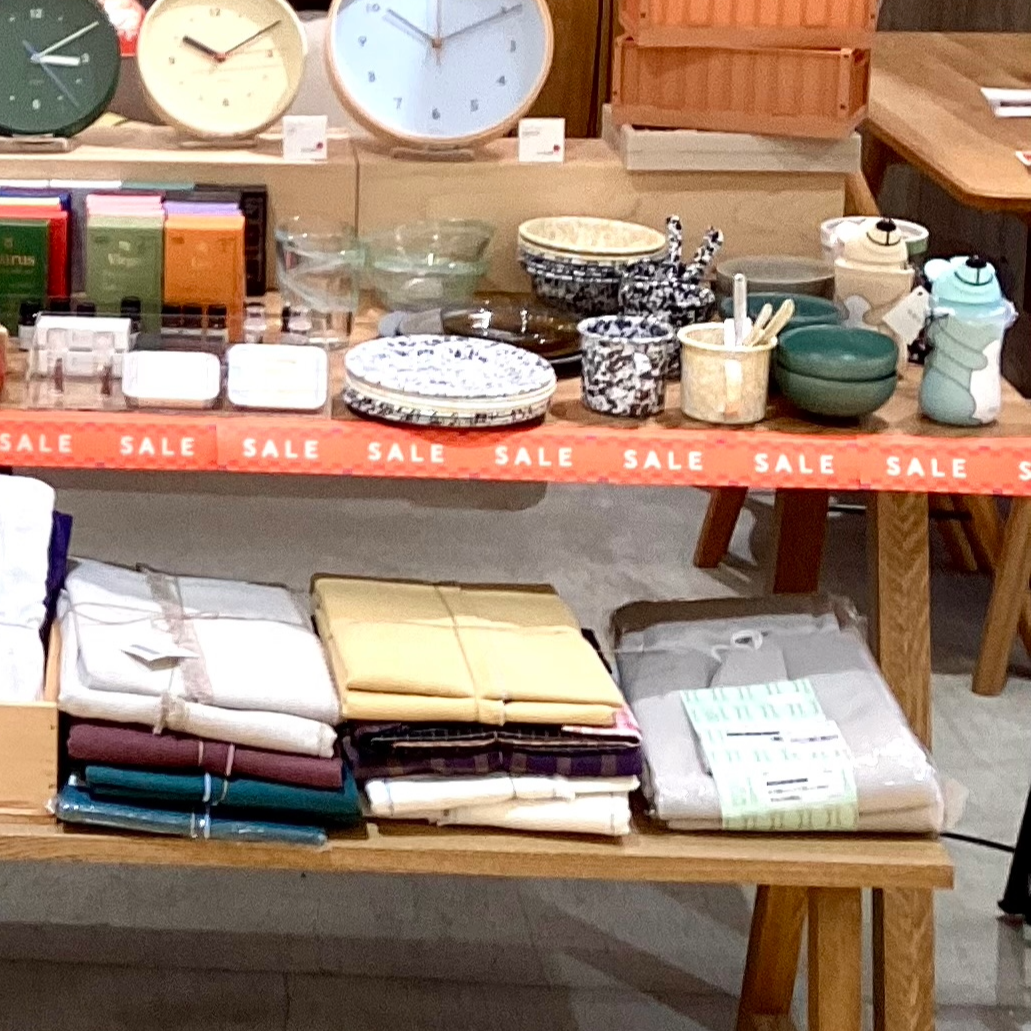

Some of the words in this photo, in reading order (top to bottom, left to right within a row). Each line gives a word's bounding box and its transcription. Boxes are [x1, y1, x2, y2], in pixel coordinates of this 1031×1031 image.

[366, 3, 380, 13] 10
[393, 97, 403, 110] 7
[431, 107, 441, 120] 6
[120, 435, 195, 456] SALE
[243, 437, 319, 459] SALE
[368, 442, 445, 463] SALE
[495, 445, 573, 467] SALE
[624, 449, 703, 471] SALE
[754, 453, 835, 475] SALE
[886, 456, 967, 479] SALE
